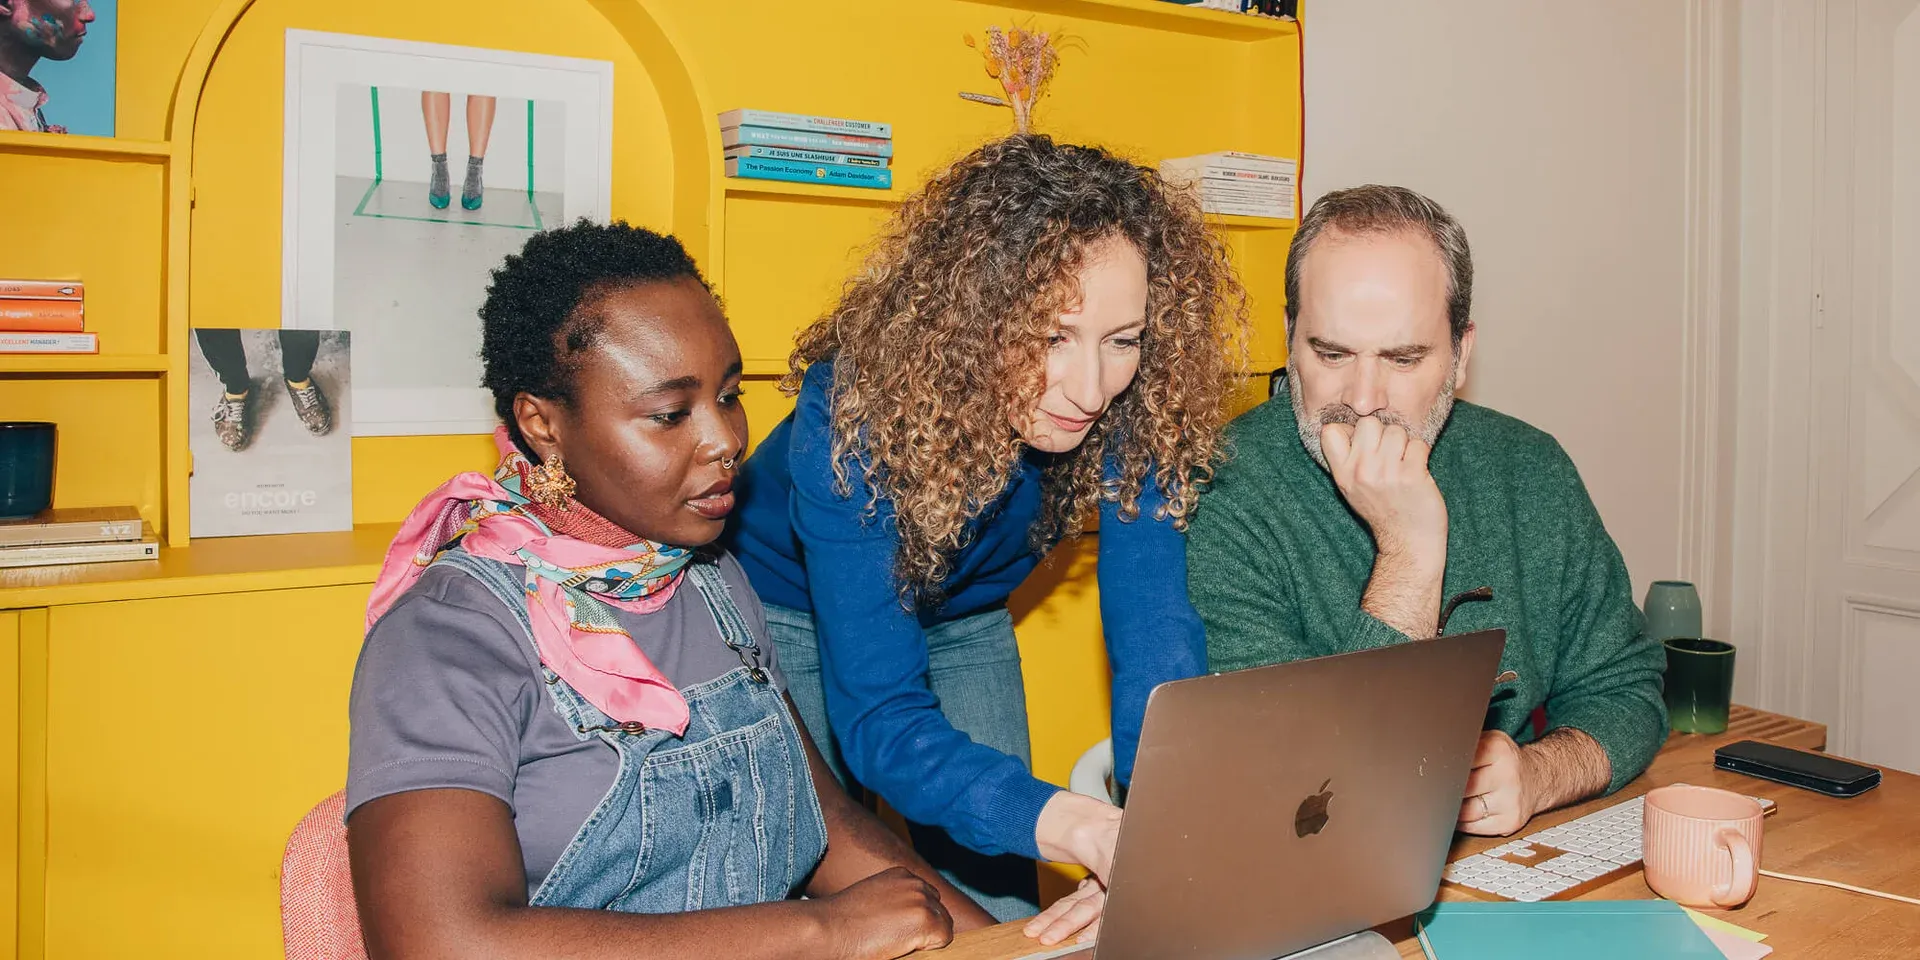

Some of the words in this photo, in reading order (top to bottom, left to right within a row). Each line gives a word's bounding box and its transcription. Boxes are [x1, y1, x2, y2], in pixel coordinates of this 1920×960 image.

[813, 118, 844, 127] CHALLENGER
[845, 121, 871, 130] CUSTOMER
[776, 150, 790, 158] SUIS
[804, 153, 836, 162] SLASHEUSE
[746, 163, 759, 171] The
[759, 164, 784, 173] Passion
[784, 166, 814, 176] Economy
[828, 171, 847, 179] Adam
[847, 172, 875, 180] Davidson
[224, 488, 317, 509] encore
[101, 524, 132, 536] XYZ
